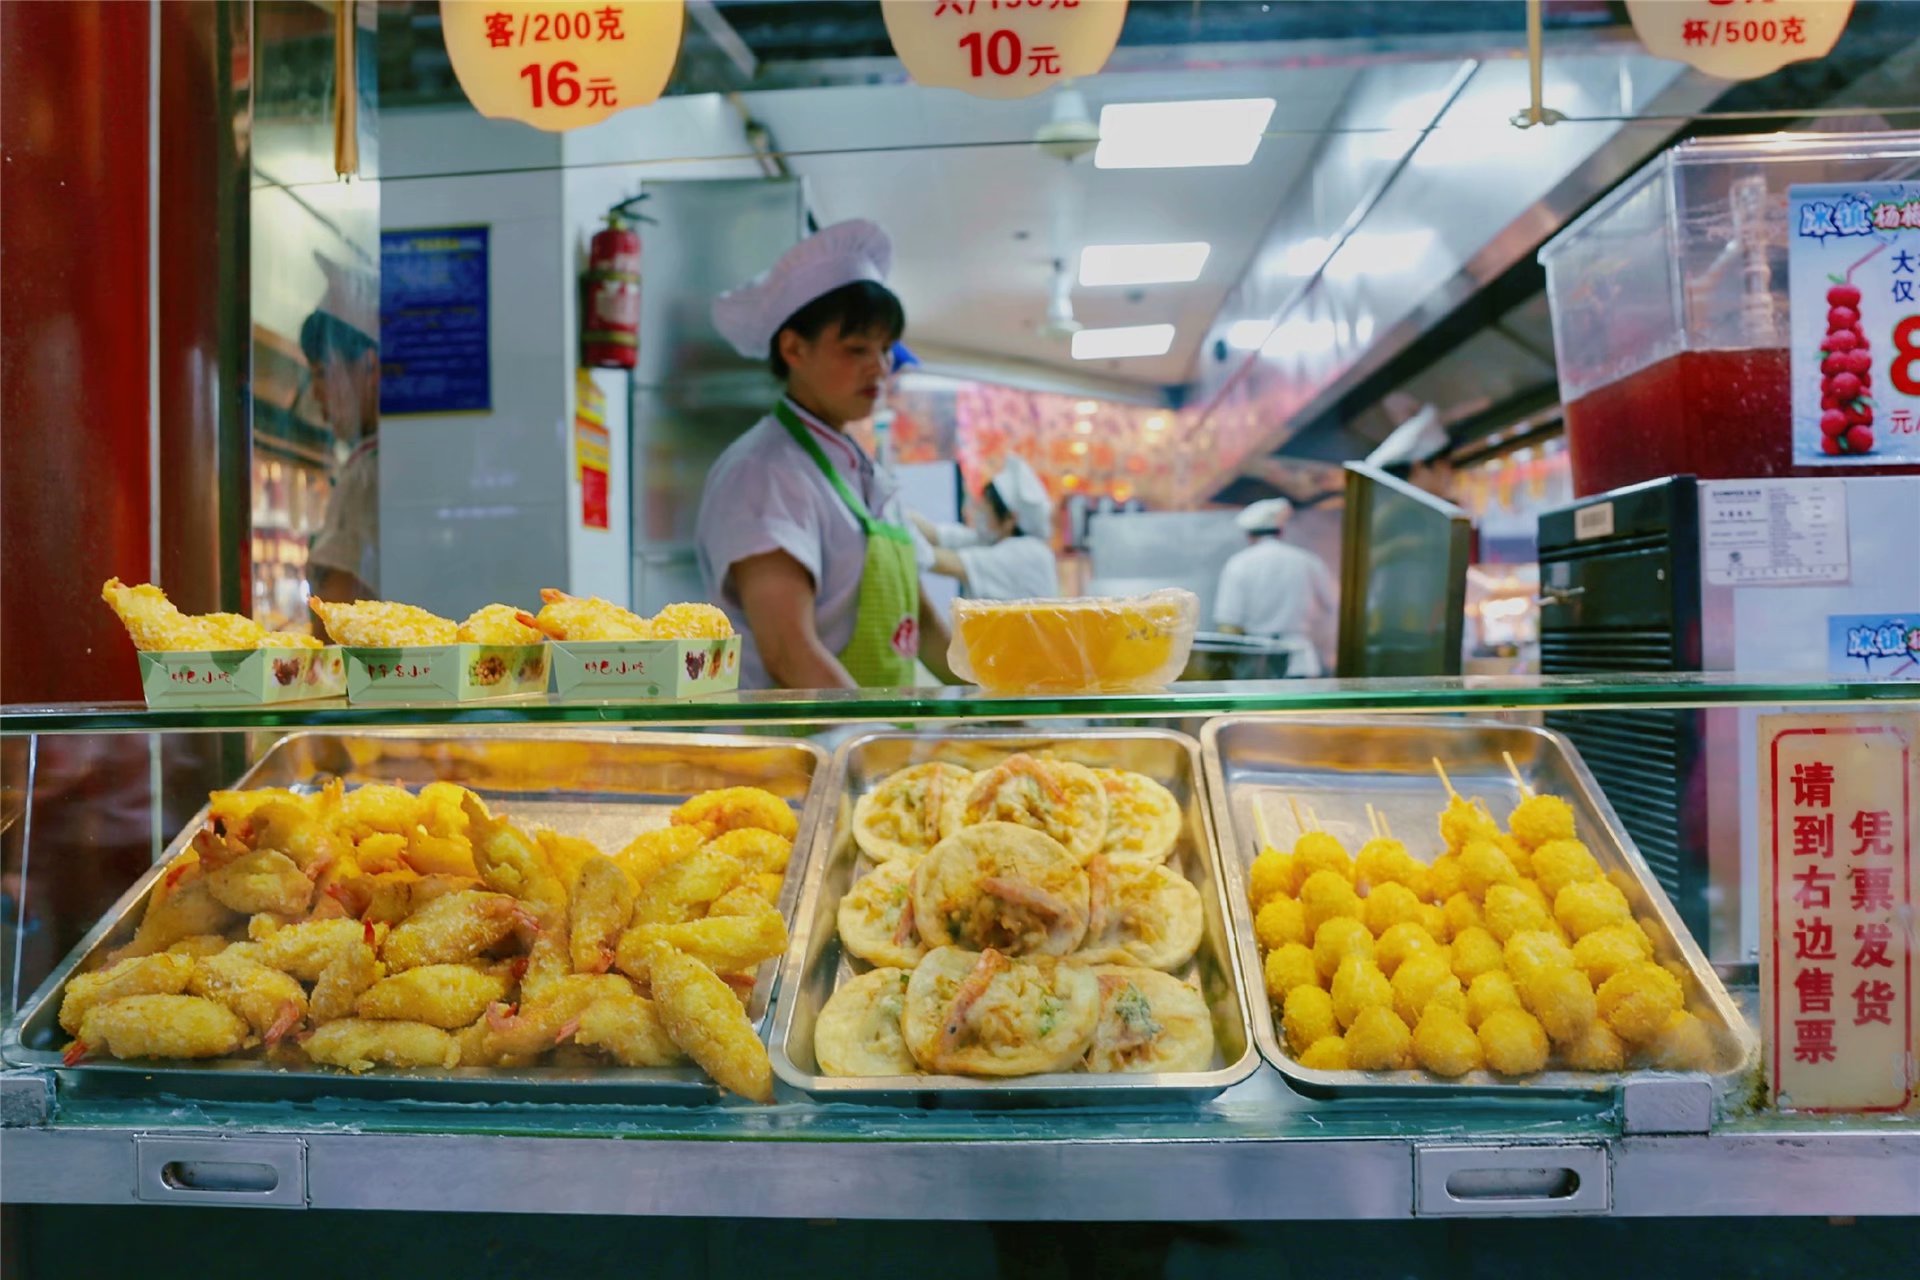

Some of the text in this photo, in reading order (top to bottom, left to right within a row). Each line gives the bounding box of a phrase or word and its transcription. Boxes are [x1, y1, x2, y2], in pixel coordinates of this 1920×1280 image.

[484, 8, 625, 48] 客/200克
[1682, 16, 1806, 46] 杯/500克
[958, 29, 1061, 77] 10元
[520, 60, 617, 108] 16元
[1891, 250, 1920, 274] 大
[1891, 279, 1920, 303] 仅
[1790, 761, 1837, 1064] 请到右边售票
[1849, 810, 1895, 1026] 凭票发货
